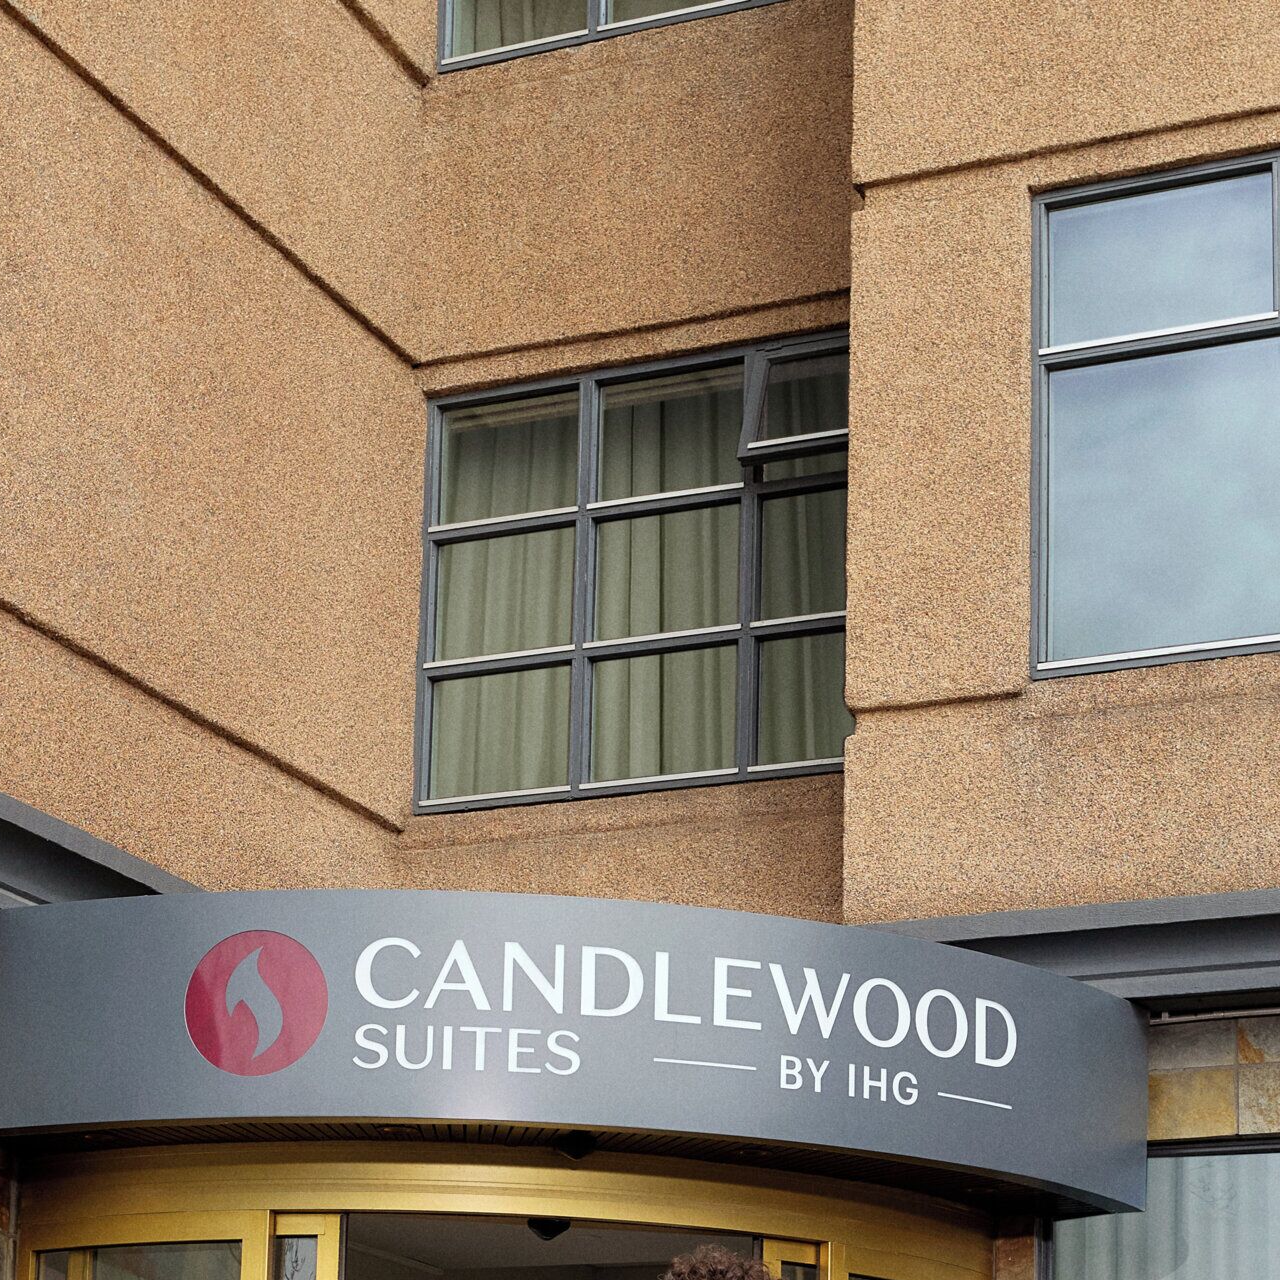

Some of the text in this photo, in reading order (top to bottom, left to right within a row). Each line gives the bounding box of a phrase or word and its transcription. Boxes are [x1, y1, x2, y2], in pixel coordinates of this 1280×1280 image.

[353, 936, 1017, 1069] CANDLEWOOD
[352, 1023, 581, 1076] SUITES
[780, 1055, 919, 1106] BY IHG
